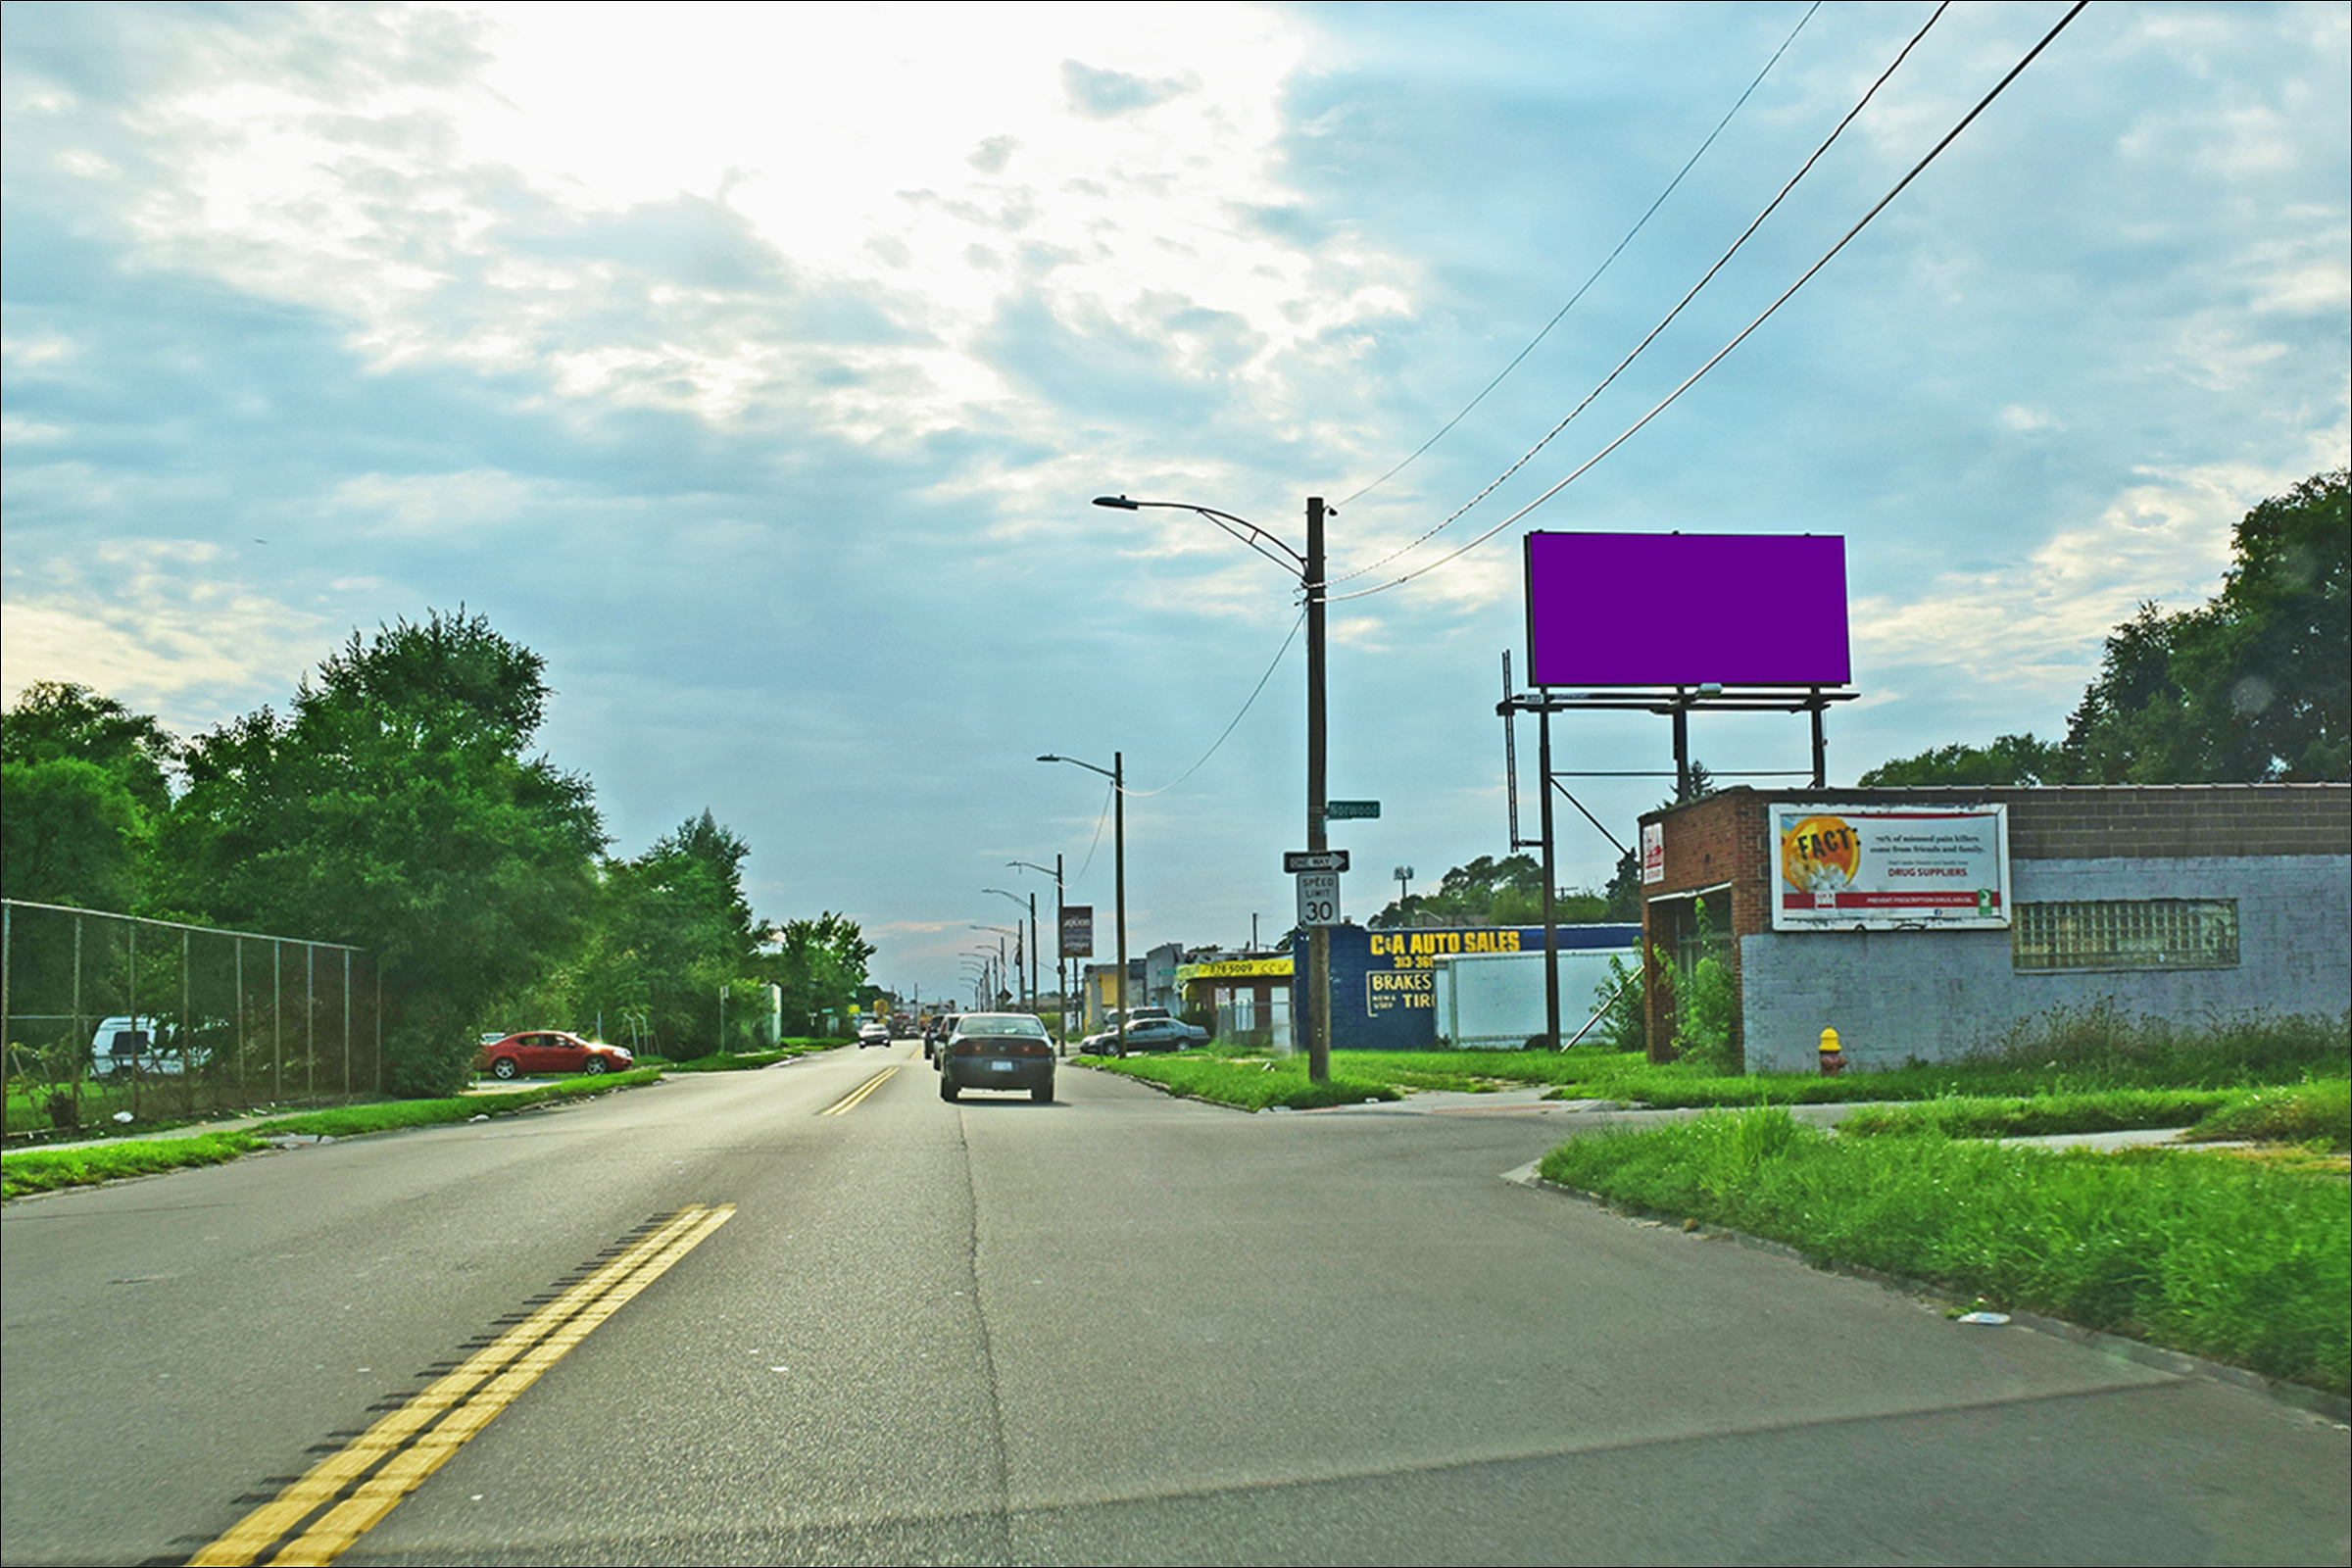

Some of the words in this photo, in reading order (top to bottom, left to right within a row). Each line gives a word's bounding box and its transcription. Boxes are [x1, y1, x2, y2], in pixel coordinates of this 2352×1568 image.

[1329, 804, 1378, 816] Norwood
[1936, 835, 1953, 844] pain
[1887, 867, 1916, 877] DRUG
[1302, 876, 1334, 887] SPEED
[1305, 901, 1333, 921] 30
[1409, 932, 1460, 955] AUTO
[1464, 931, 1520, 953] SALES
[1372, 973, 1432, 991] BRAKES
